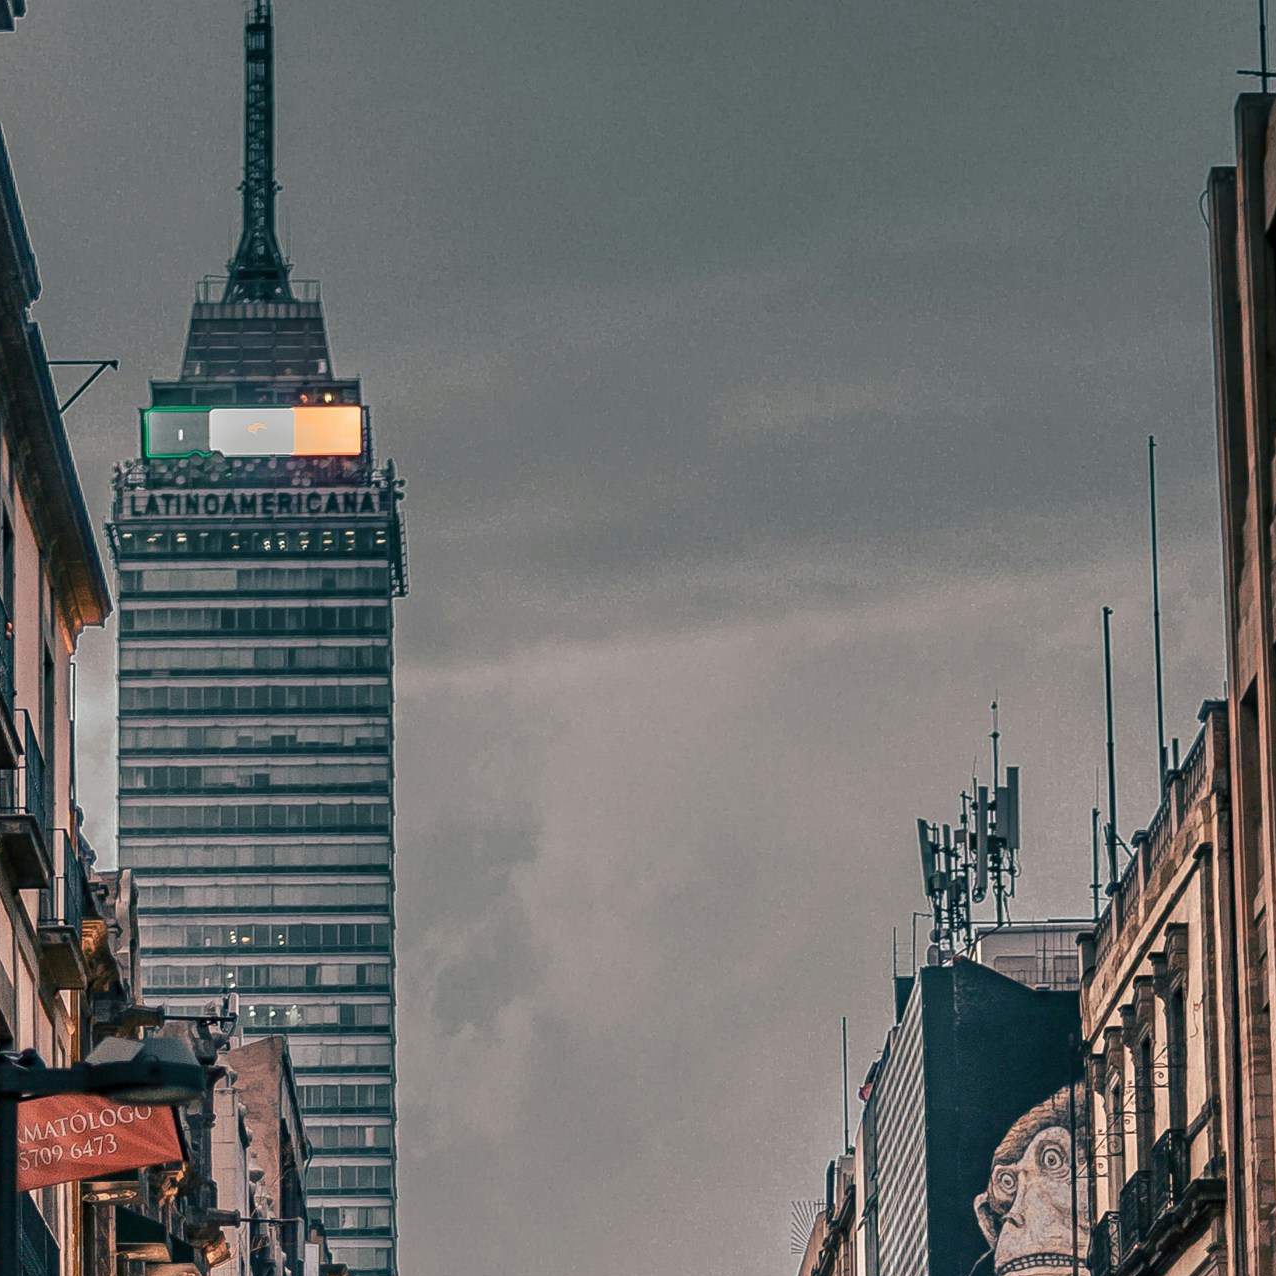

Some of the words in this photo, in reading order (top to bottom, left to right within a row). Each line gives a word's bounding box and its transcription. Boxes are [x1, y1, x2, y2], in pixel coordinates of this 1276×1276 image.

[129, 491, 376, 516] LATINOAMERICANA
[19, 1144, 64, 1171] 5709
[70, 1133, 118, 1160] 6473
